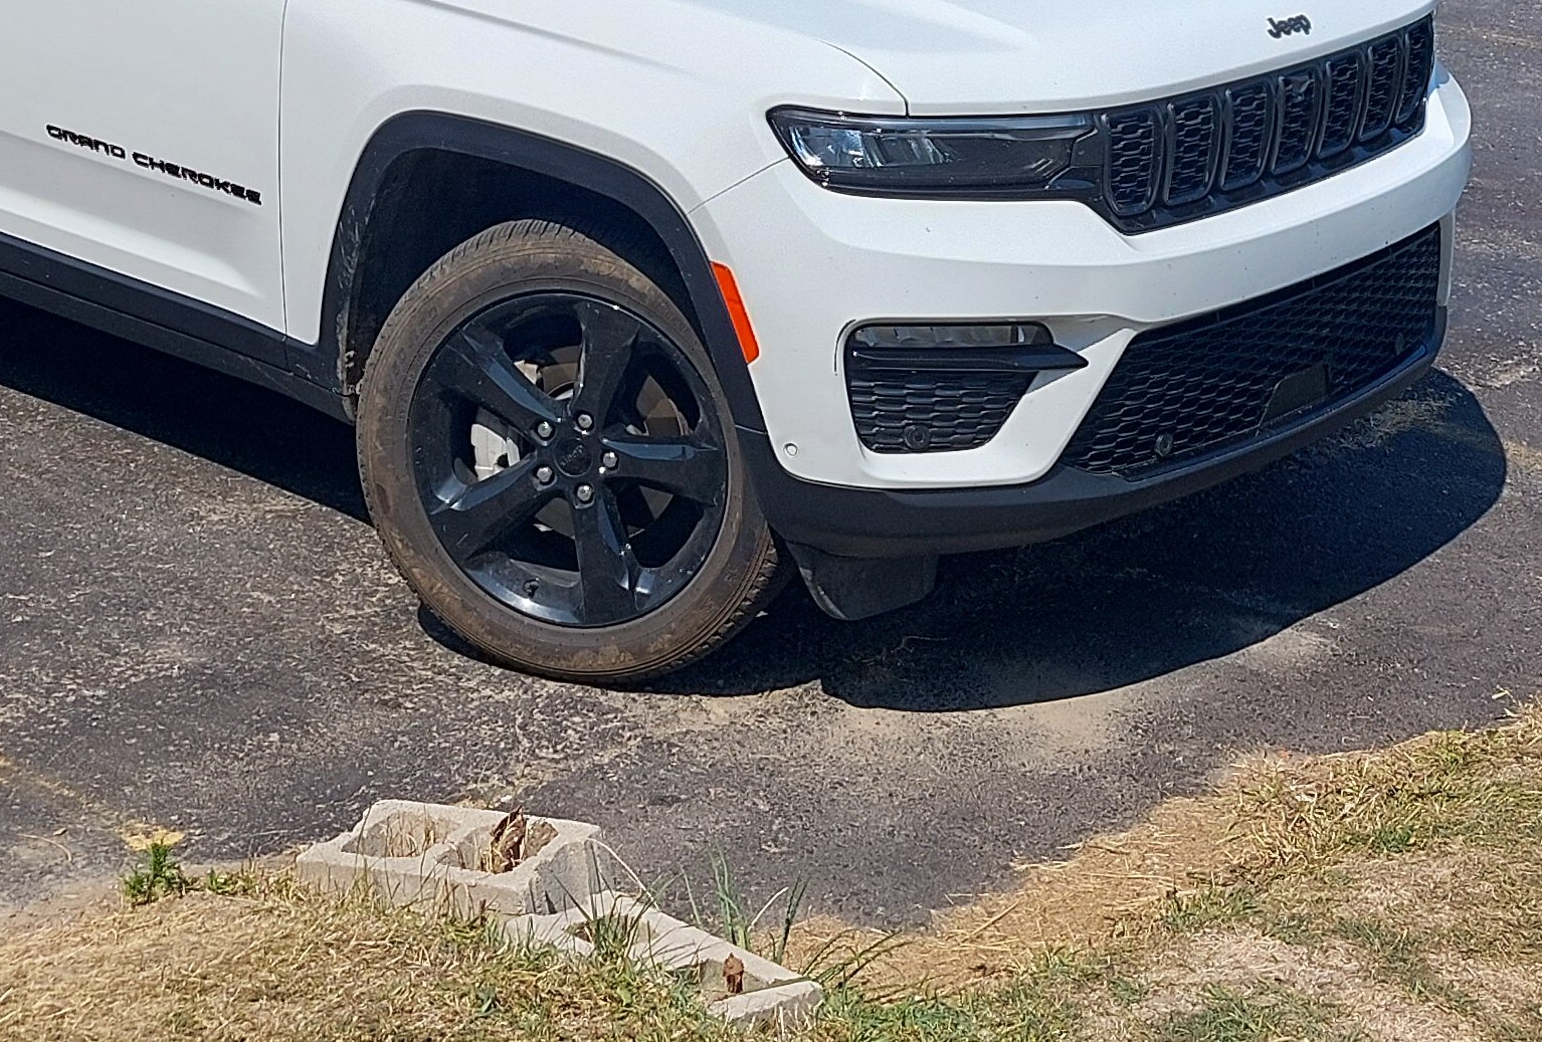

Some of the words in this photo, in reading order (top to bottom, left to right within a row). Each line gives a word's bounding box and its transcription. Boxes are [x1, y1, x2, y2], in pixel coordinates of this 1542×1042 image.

[1266, 14, 1312, 39] Jeep
[46, 124, 126, 159] GRAND
[132, 152, 262, 206] CHEROKEE
